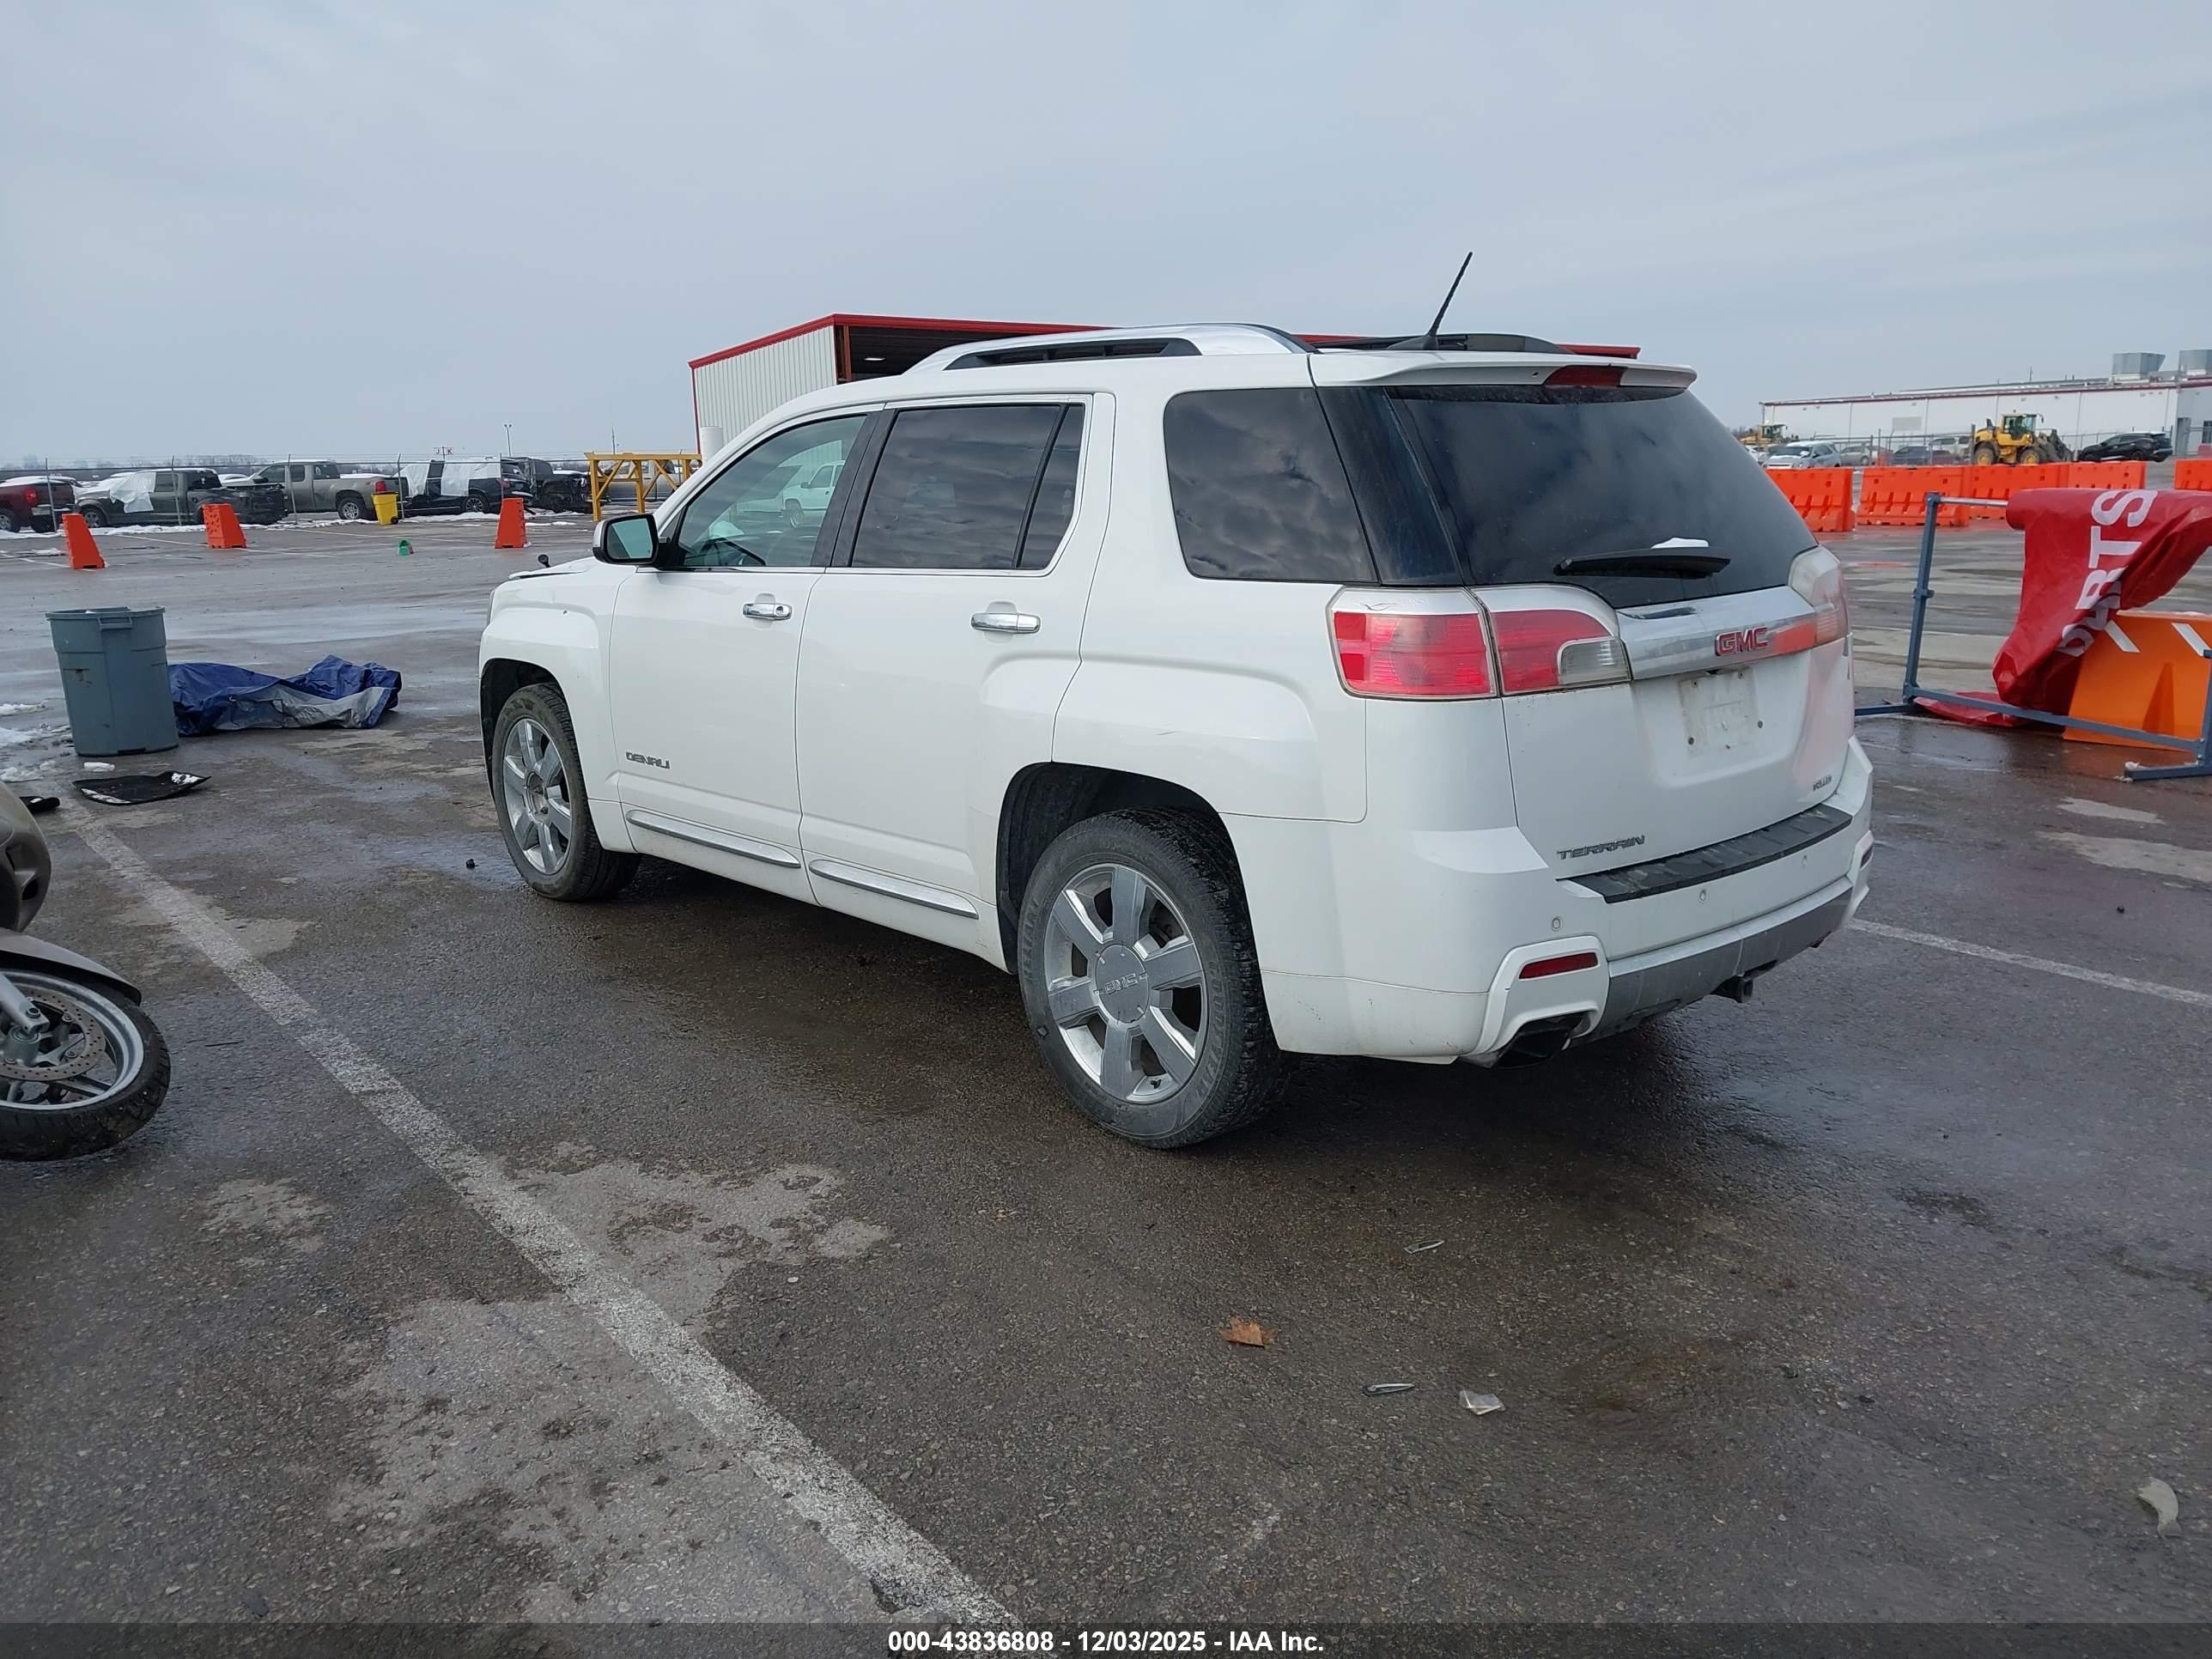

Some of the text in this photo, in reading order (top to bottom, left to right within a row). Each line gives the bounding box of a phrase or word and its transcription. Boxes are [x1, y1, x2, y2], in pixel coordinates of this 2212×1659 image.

[1714, 625, 1769, 656] GMC
[625, 751, 671, 769] DENALI
[1557, 834, 1646, 860] TERRAIN
[1105, 972, 1139, 995] GMC
